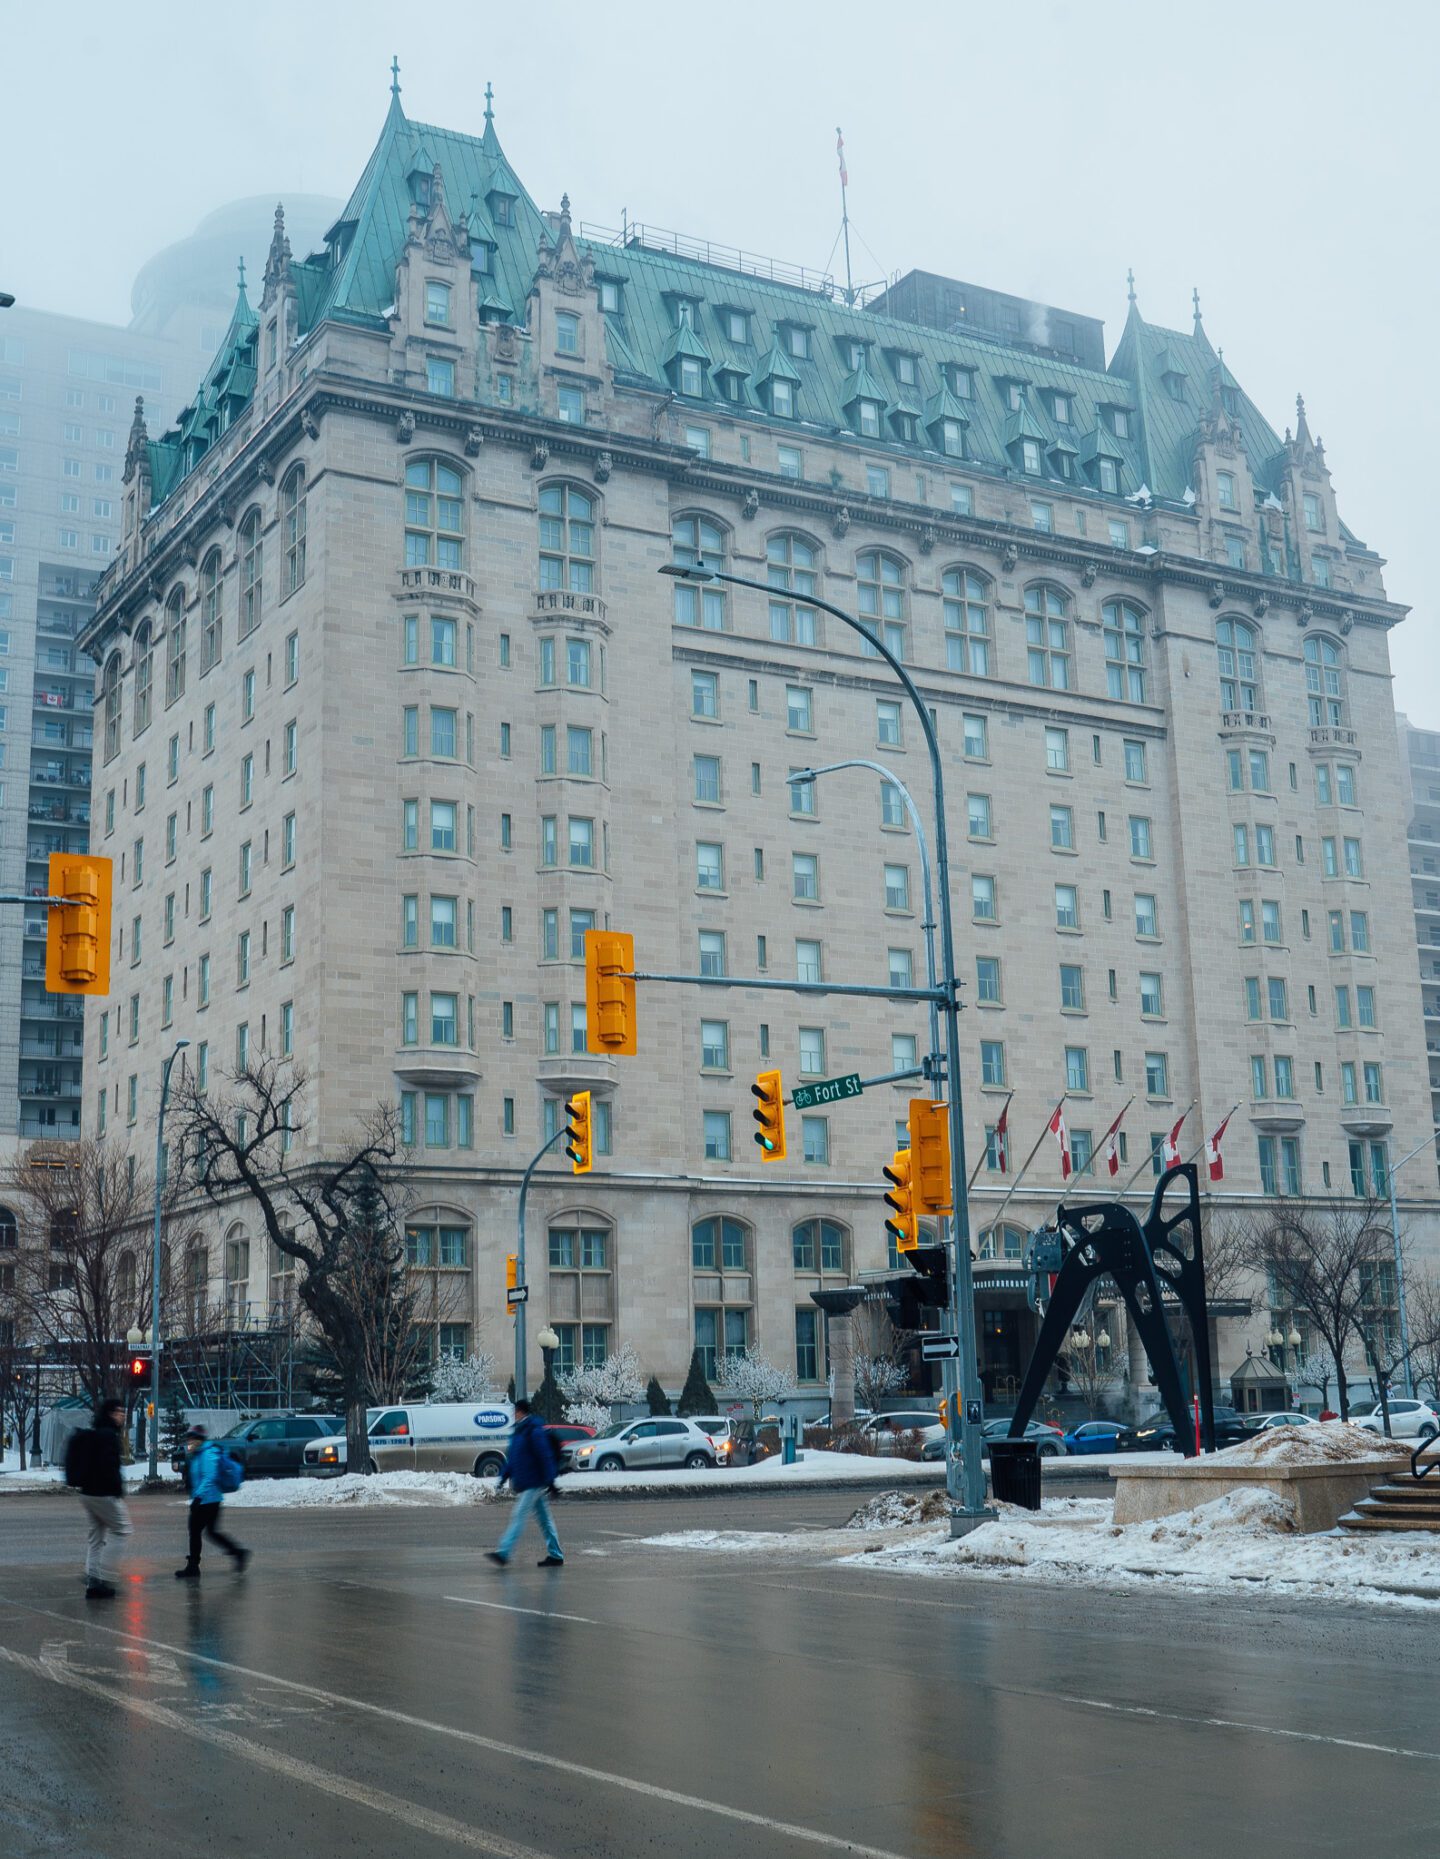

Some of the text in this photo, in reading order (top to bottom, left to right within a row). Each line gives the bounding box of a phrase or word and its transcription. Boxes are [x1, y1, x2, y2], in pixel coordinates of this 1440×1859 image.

[814, 1077, 860, 1102] Fort St
[477, 1415, 506, 1423] PARSONS
